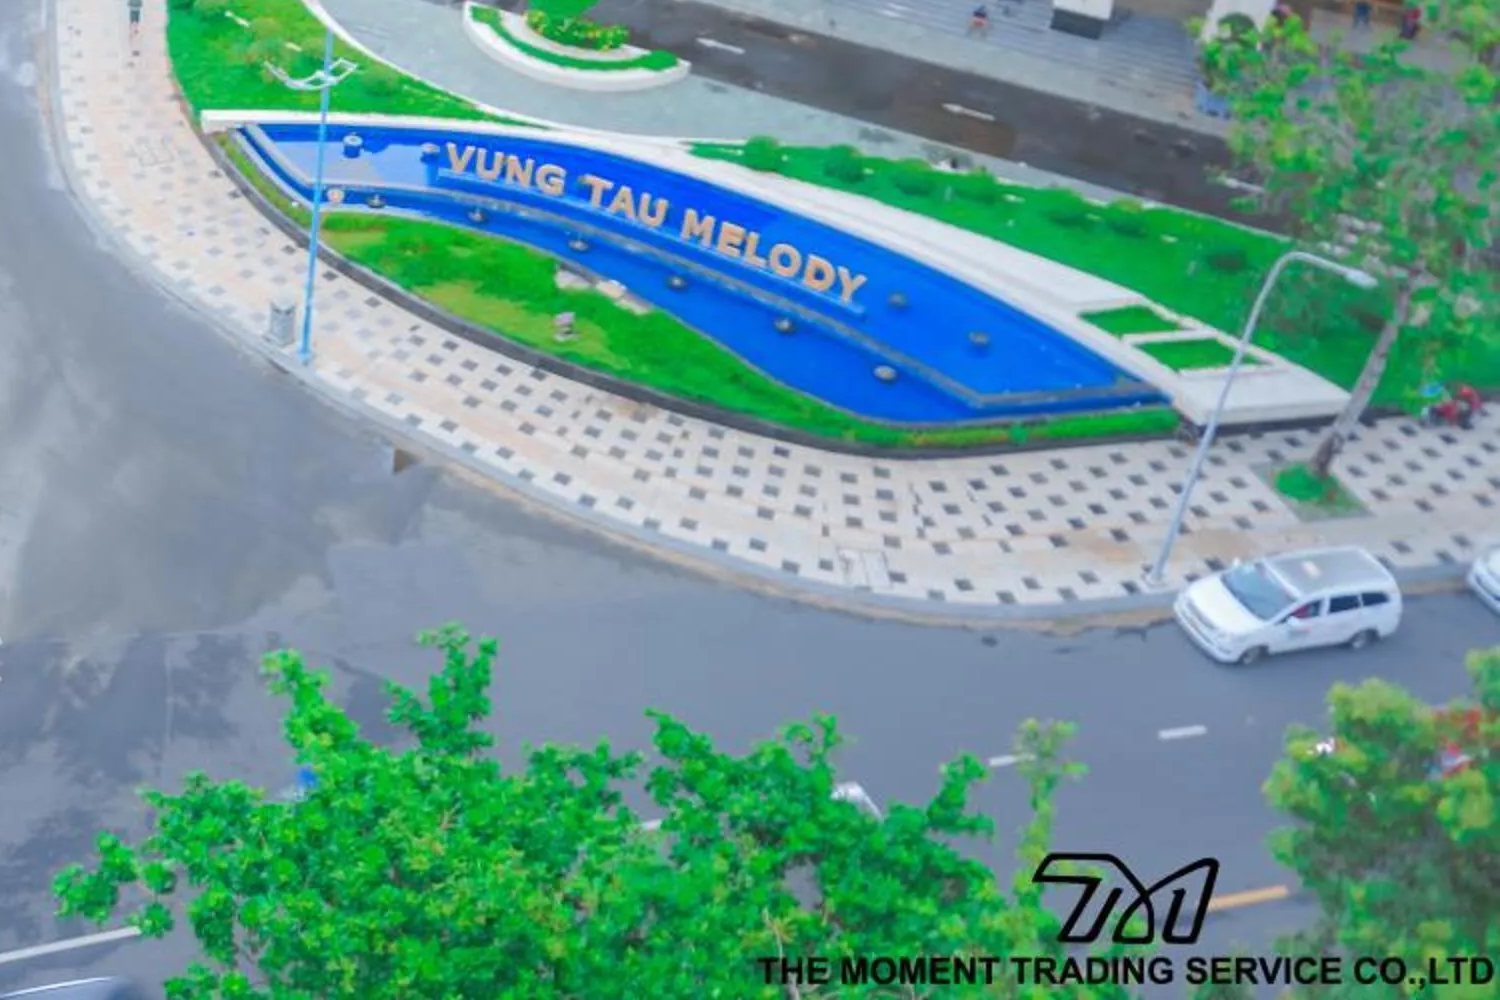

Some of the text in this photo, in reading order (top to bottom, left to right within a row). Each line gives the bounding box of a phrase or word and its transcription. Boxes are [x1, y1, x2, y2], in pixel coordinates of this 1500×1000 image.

[445, 142, 868, 303] VUNG TAU MELODY
